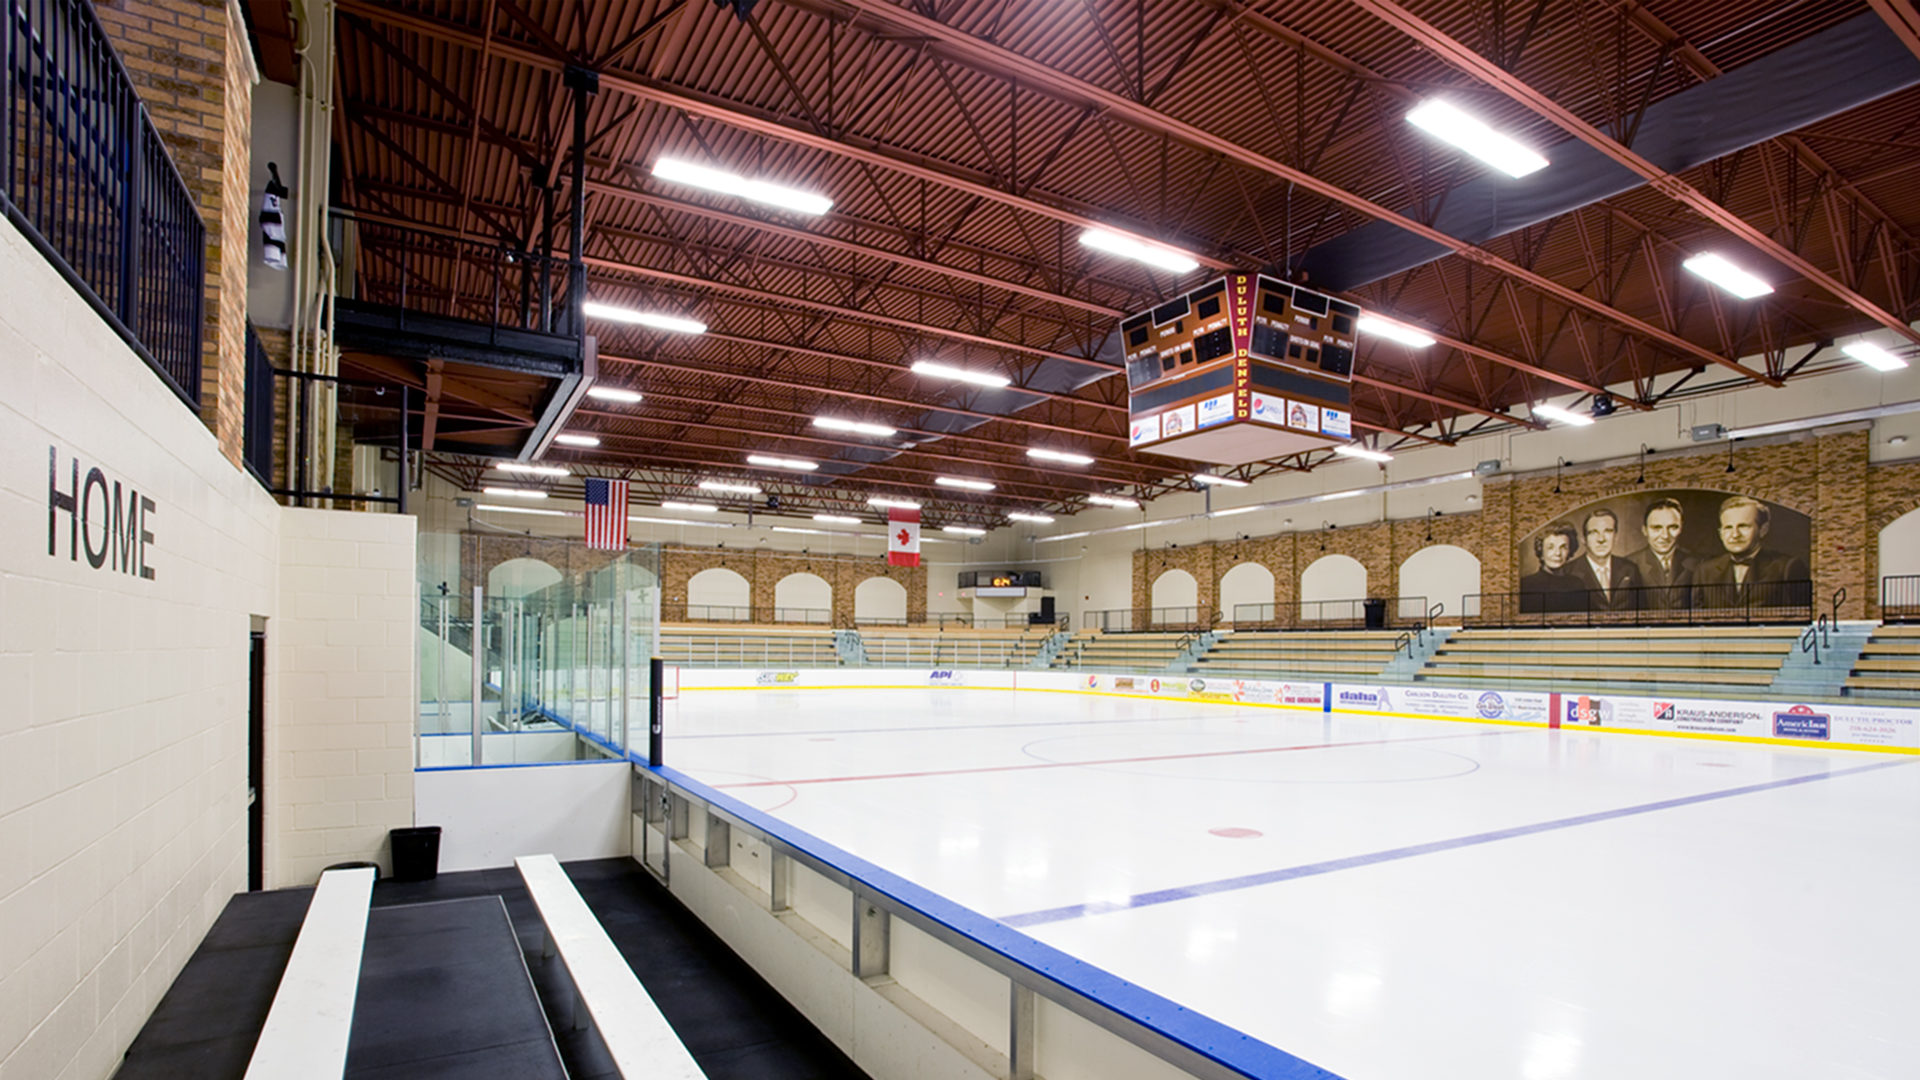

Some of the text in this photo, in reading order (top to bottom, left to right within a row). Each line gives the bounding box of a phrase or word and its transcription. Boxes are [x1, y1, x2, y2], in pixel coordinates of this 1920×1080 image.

[1236, 275, 1248, 418] DULUTH DENFELD
[48, 444, 156, 581] HOME
